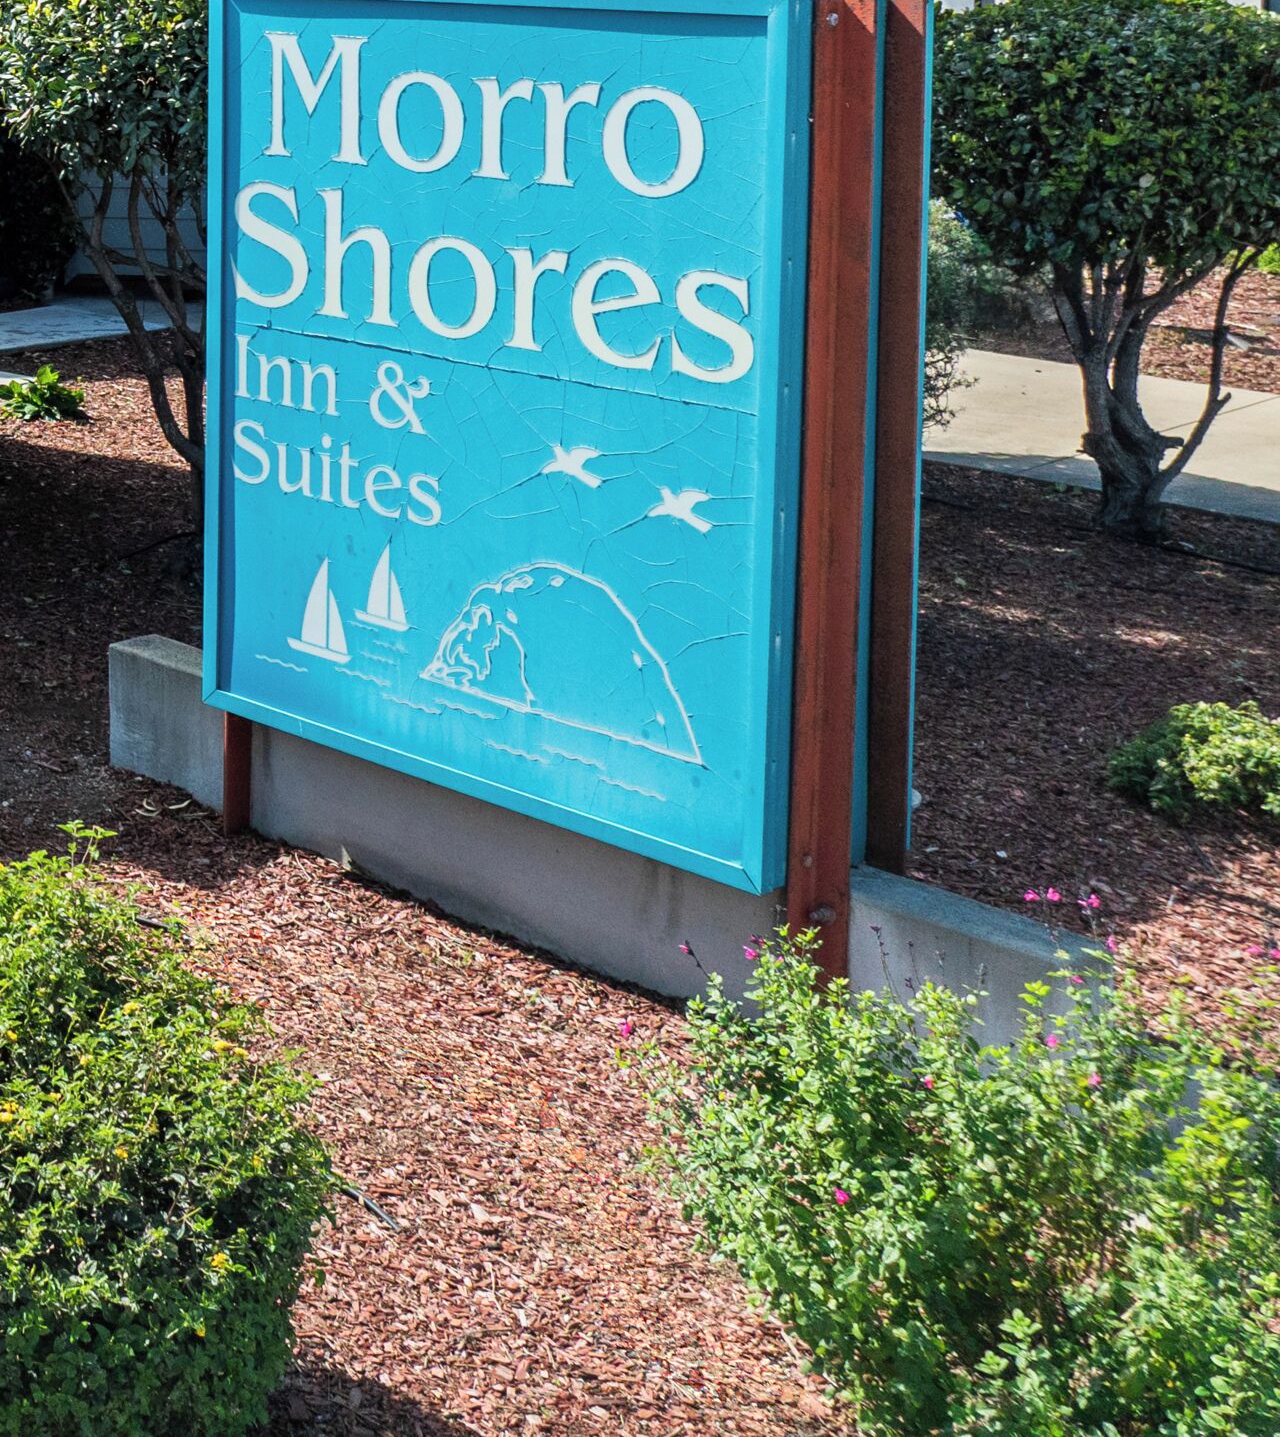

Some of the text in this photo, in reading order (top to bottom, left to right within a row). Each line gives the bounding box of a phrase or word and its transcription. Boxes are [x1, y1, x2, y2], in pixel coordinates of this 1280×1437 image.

[265, 32, 705, 199] Morro
[233, 182, 755, 383] Shores
[234, 334, 431, 435] Inn &
[233, 420, 442, 527] Suites
